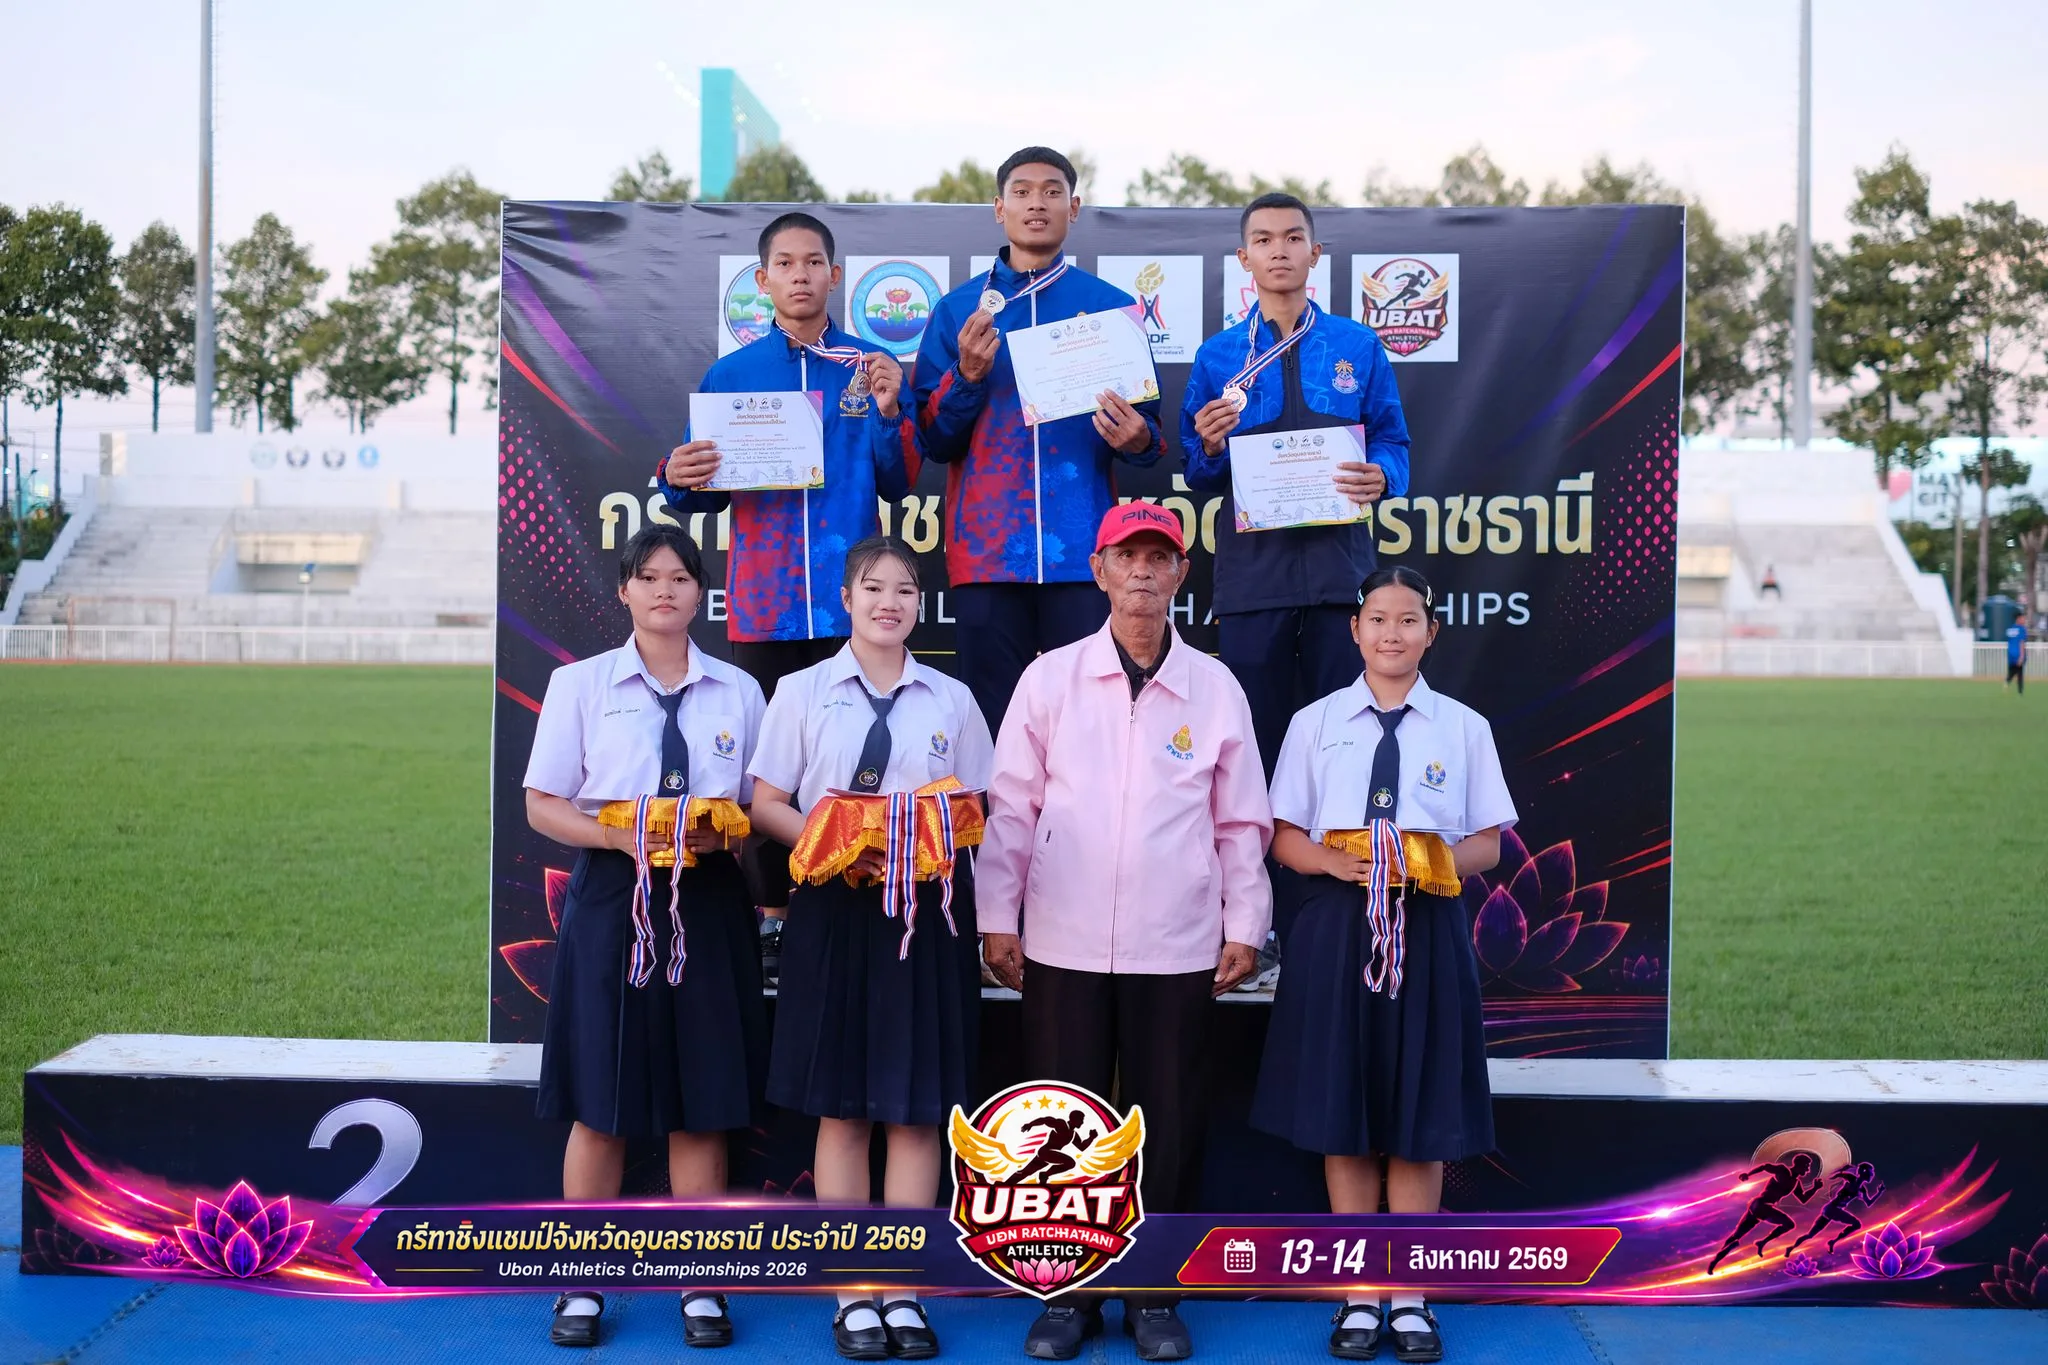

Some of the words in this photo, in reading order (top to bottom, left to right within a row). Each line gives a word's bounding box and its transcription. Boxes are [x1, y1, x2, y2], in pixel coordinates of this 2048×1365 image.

[1368, 309, 1442, 328] UBAT
[1121, 509, 1173, 527] PING
[308, 1097, 423, 1208] 2
